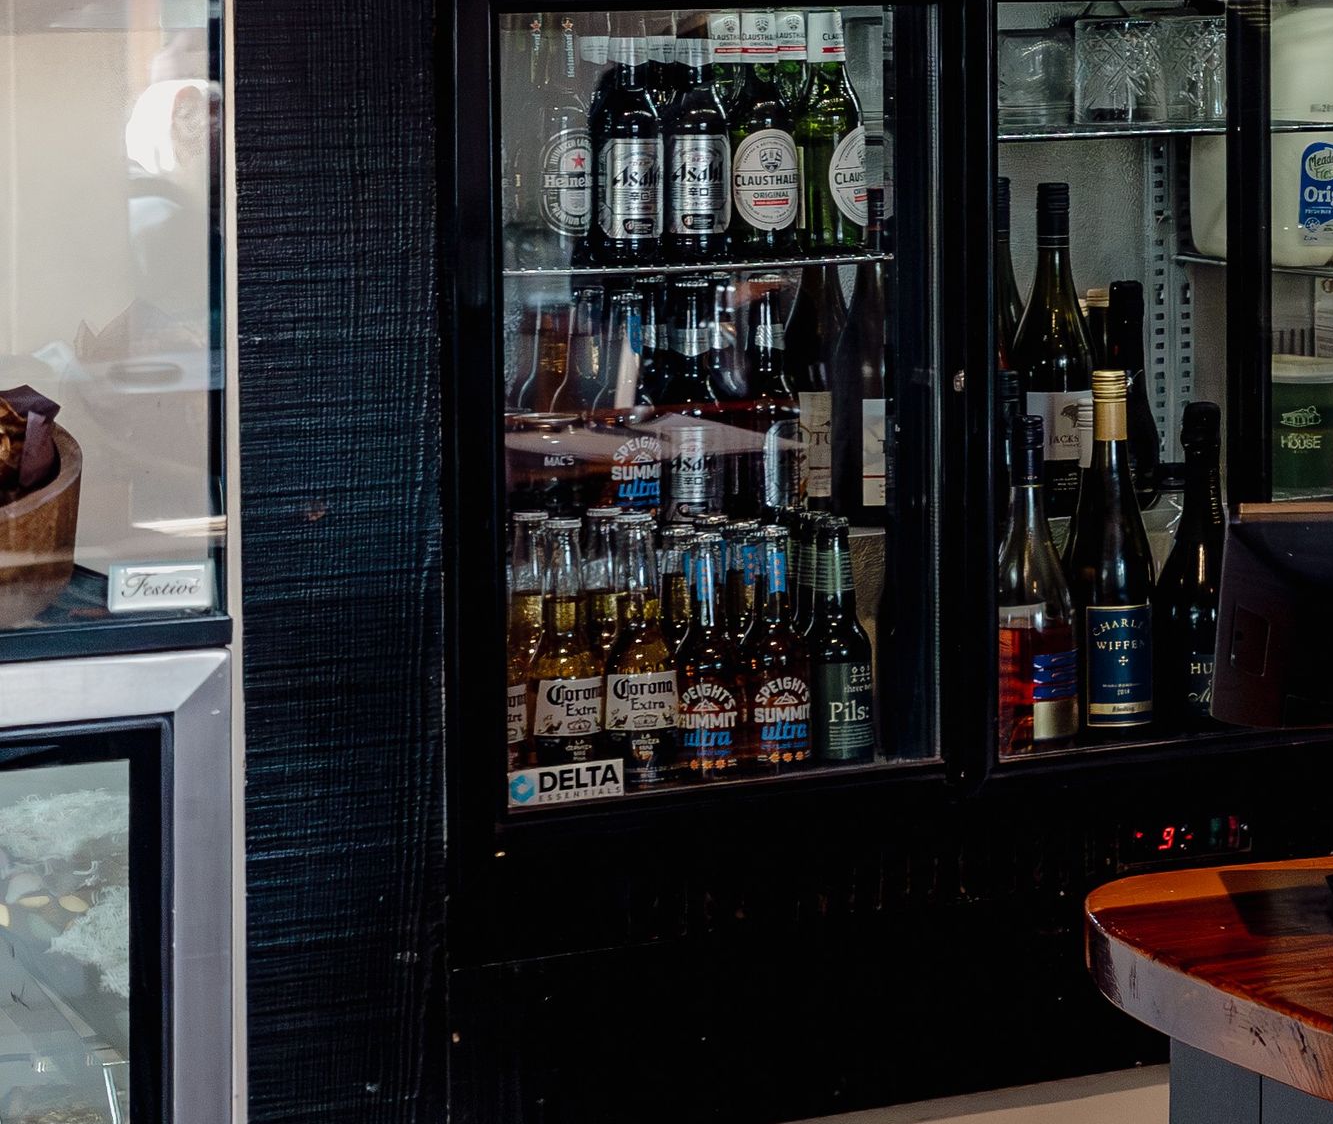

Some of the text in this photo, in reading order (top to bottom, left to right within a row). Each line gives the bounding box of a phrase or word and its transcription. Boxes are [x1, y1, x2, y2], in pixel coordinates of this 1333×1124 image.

[613, 678, 674, 702] Corona
[631, 697, 666, 711] Extra
[754, 702, 812, 724] SUMMIT
[760, 721, 808, 742] ultra
[538, 764, 620, 794] DELTA
[538, 787, 623, 803] ESSENTIALS
